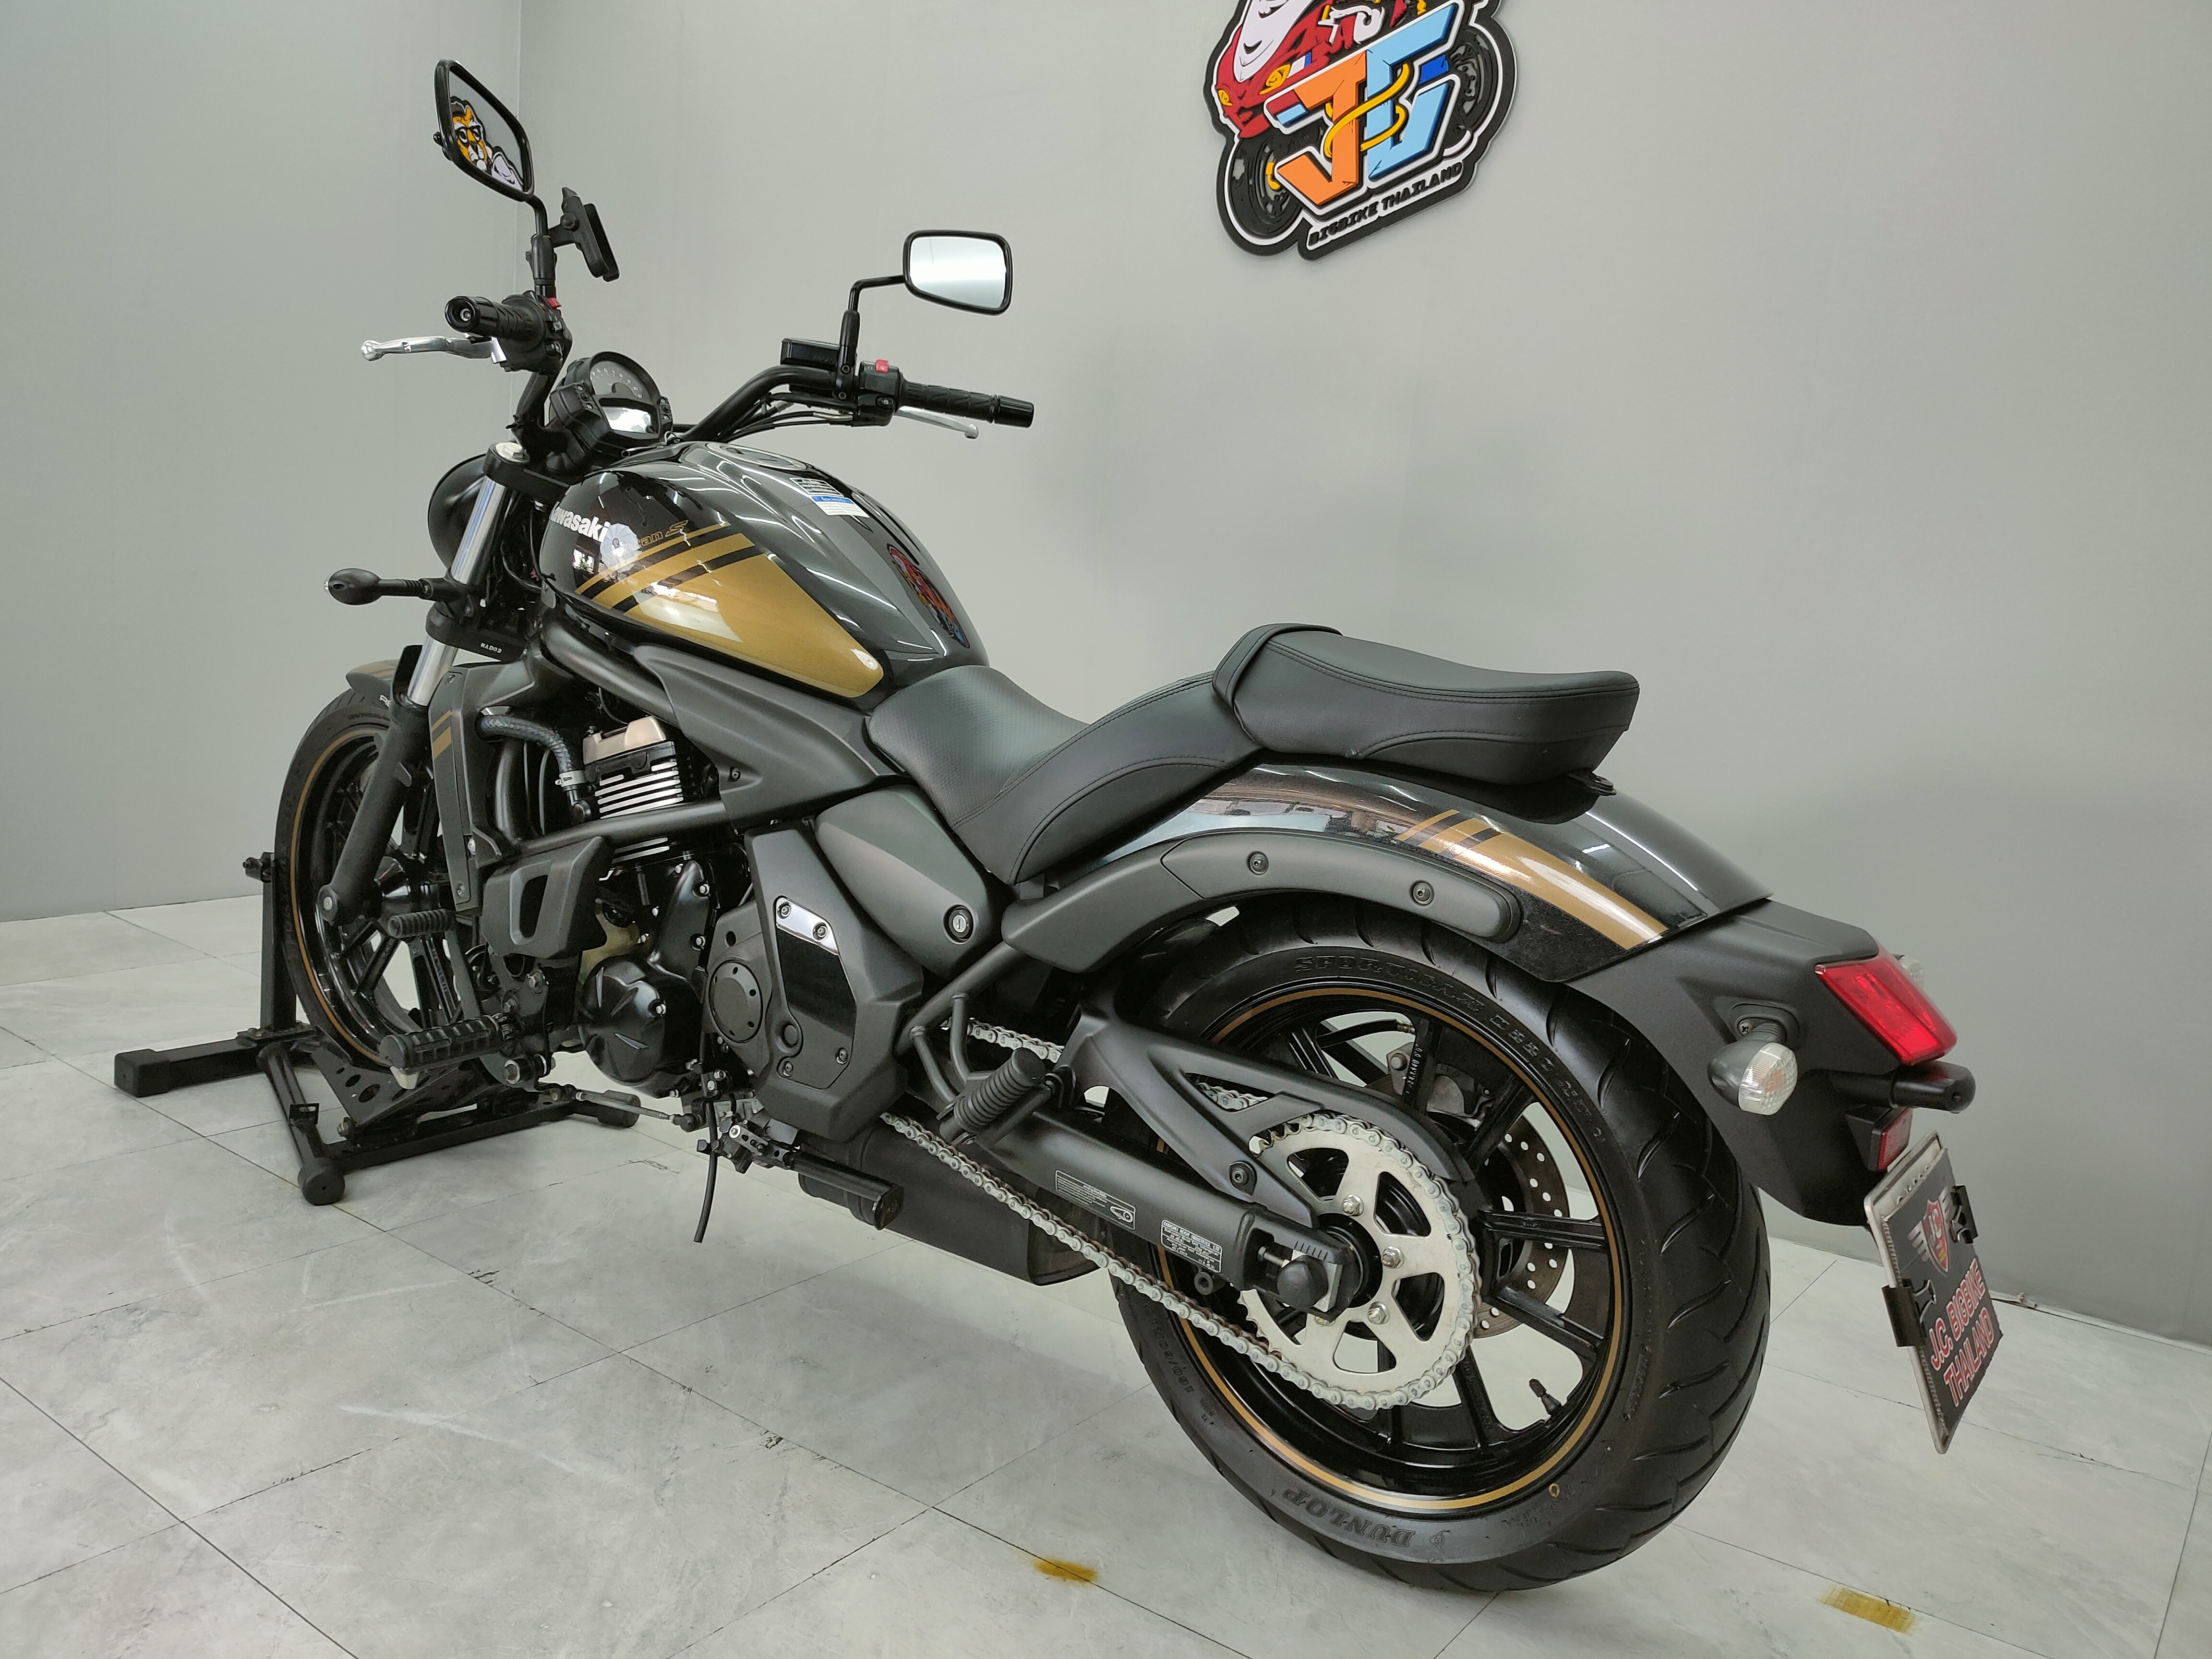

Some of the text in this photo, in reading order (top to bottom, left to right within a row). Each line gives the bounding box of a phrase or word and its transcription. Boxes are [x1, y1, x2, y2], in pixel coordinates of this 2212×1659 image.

[1308, 161, 1463, 246] BIGBIKE THAILAND
[1929, 1258, 1986, 1371] J.C. BIGBIKE
[1944, 1307, 1995, 1407] THAILAND
[1282, 1488, 1416, 1548] DUNLOP
